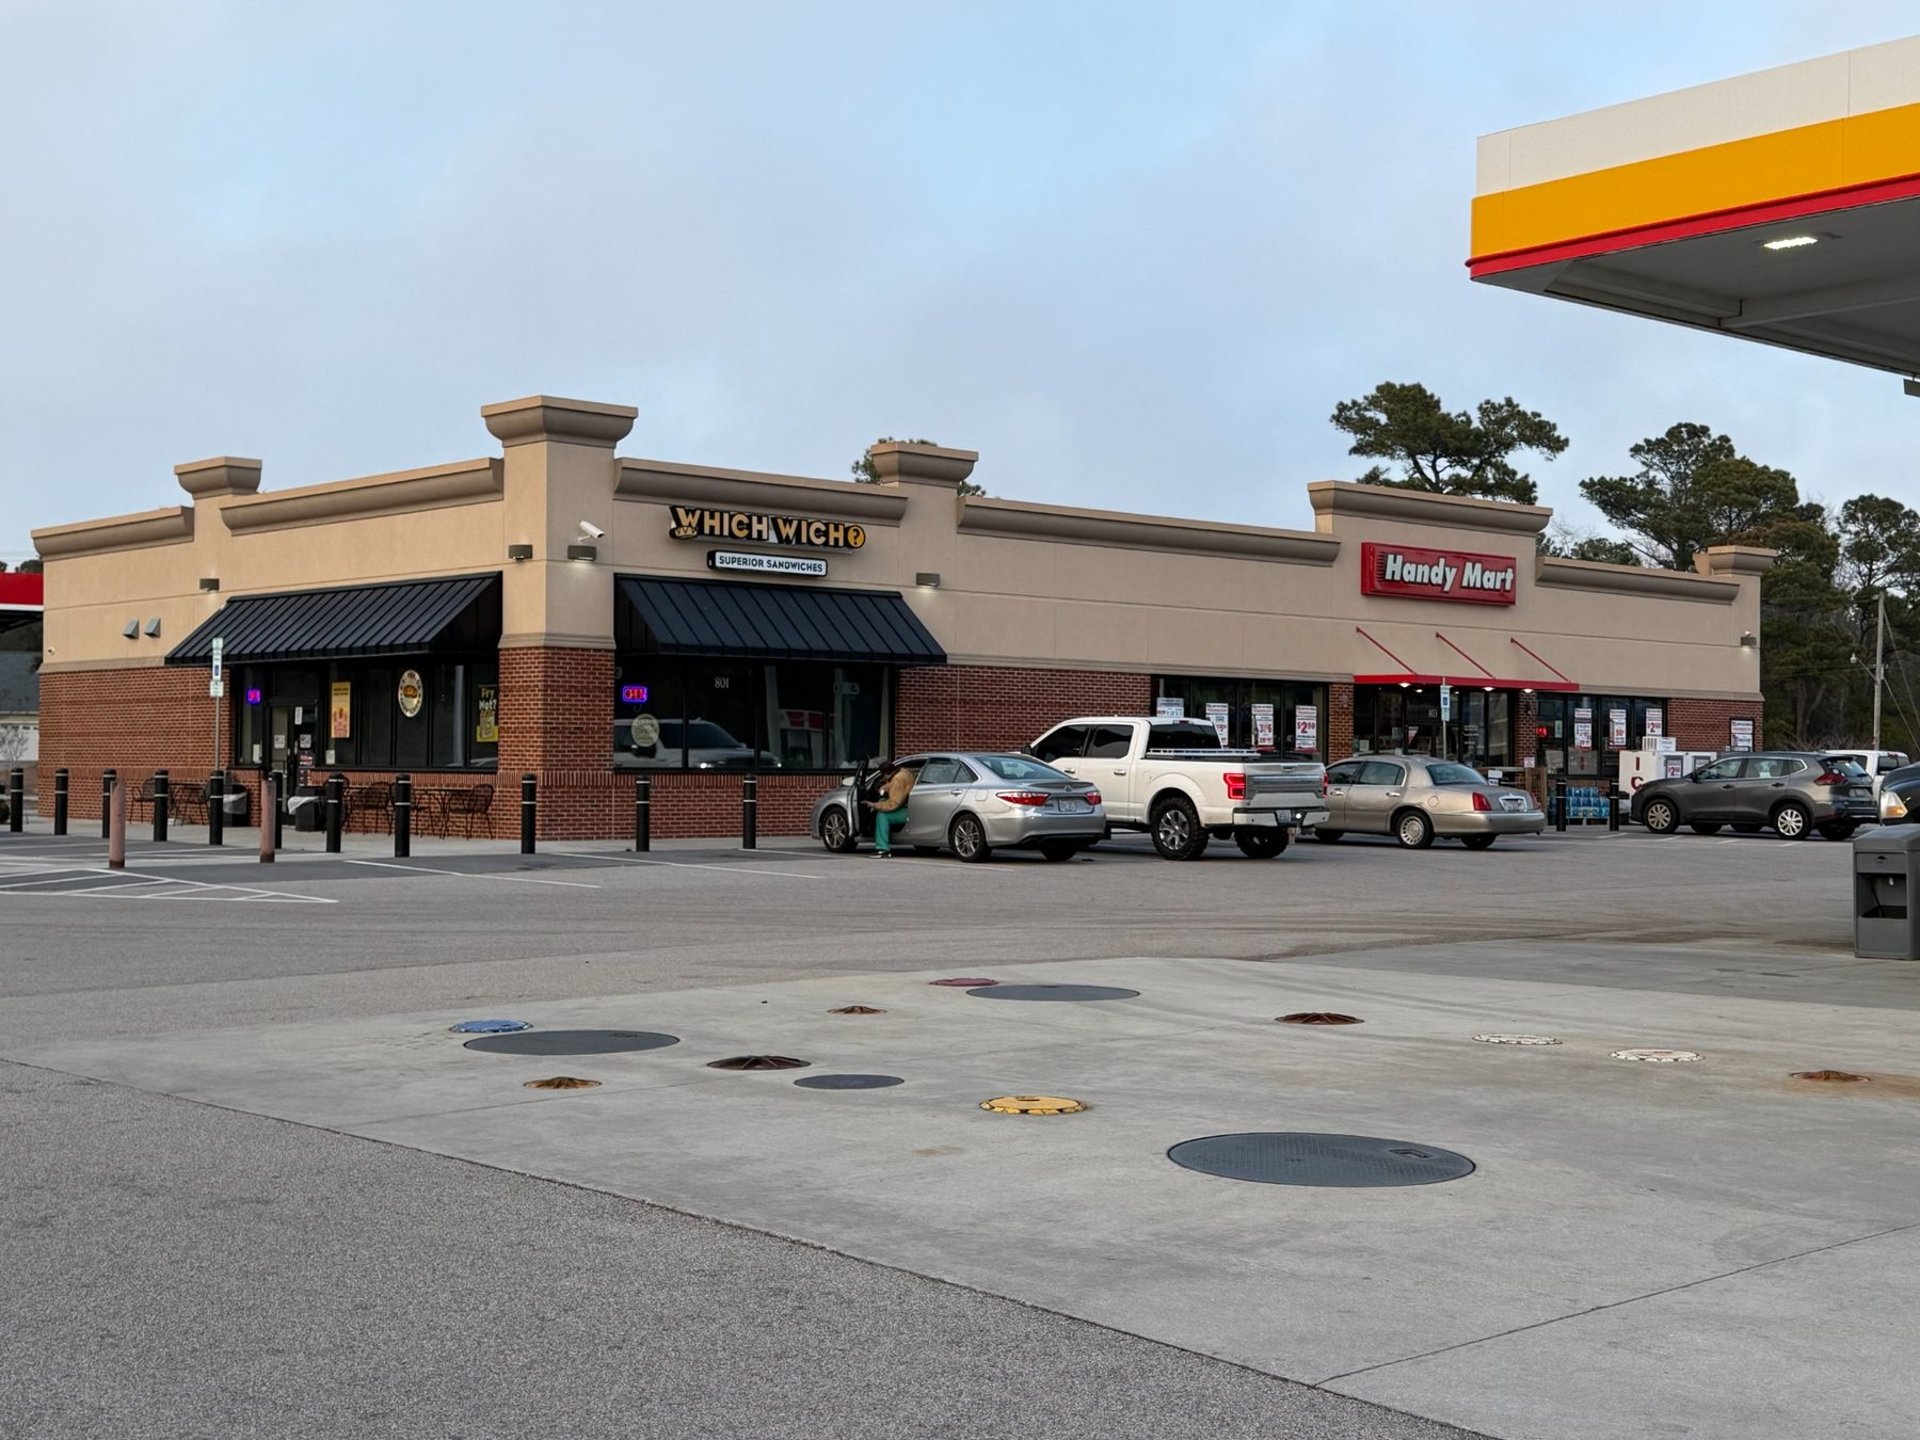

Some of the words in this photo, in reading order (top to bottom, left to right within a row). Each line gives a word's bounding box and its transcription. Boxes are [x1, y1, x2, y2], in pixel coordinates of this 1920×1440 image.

[674, 506, 769, 540] WHICH
[719, 555, 764, 569] SUPERIOR
[767, 557, 823, 573] SANDWICHES
[1385, 553, 1458, 592] Handy
[1462, 561, 1514, 591] Mart
[714, 677, 730, 689] 801
[481, 687, 495, 699] Fry
[478, 699, 498, 711] Not?
